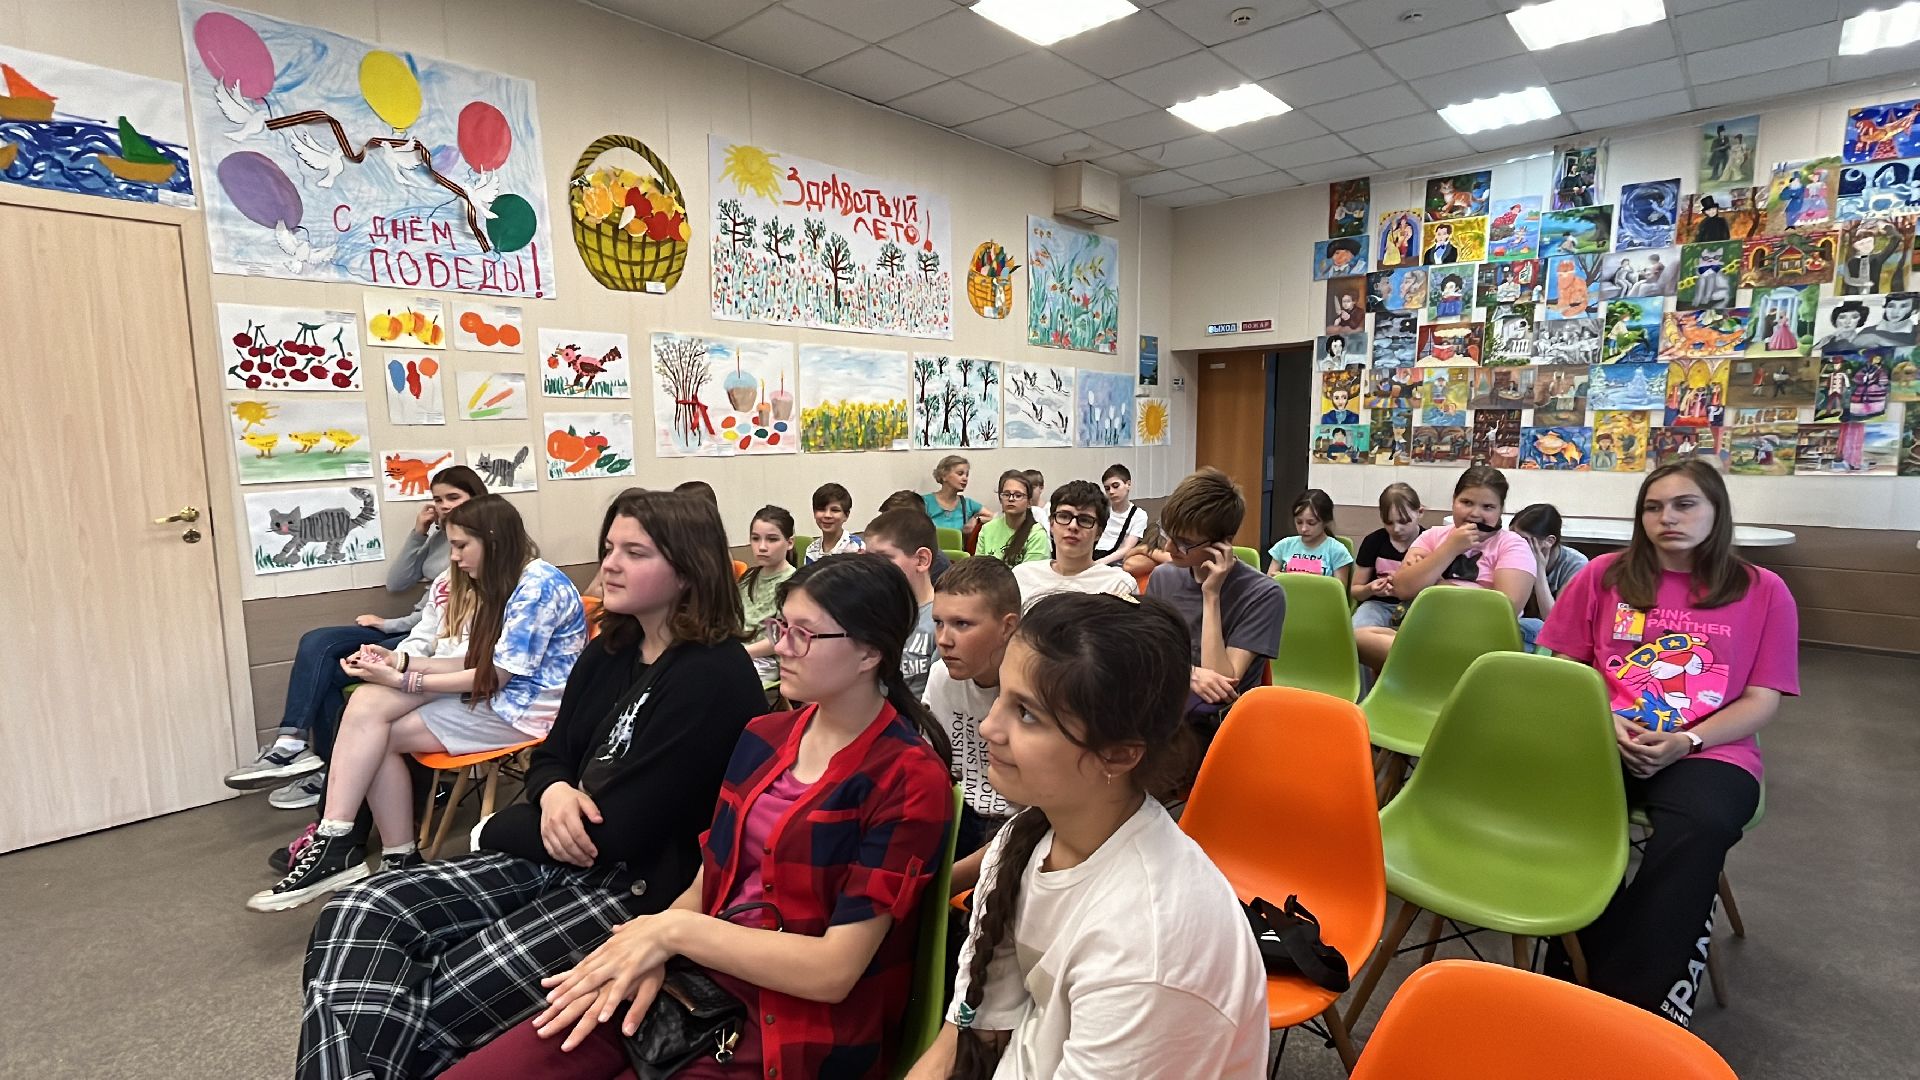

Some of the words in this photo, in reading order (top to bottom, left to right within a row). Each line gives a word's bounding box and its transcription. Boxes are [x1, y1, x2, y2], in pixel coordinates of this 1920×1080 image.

[783, 167, 918, 223] ЗДРАВСТВУЙ
[333, 204, 351, 232] С
[369, 216, 457, 251] ДНЁМ
[369, 242, 543, 298] ПОБЕДЫ!
[1647, 618, 1731, 637] PANTHER
[1649, 608, 1692, 621] PINK
[1660, 1000, 1689, 1027] BAND
